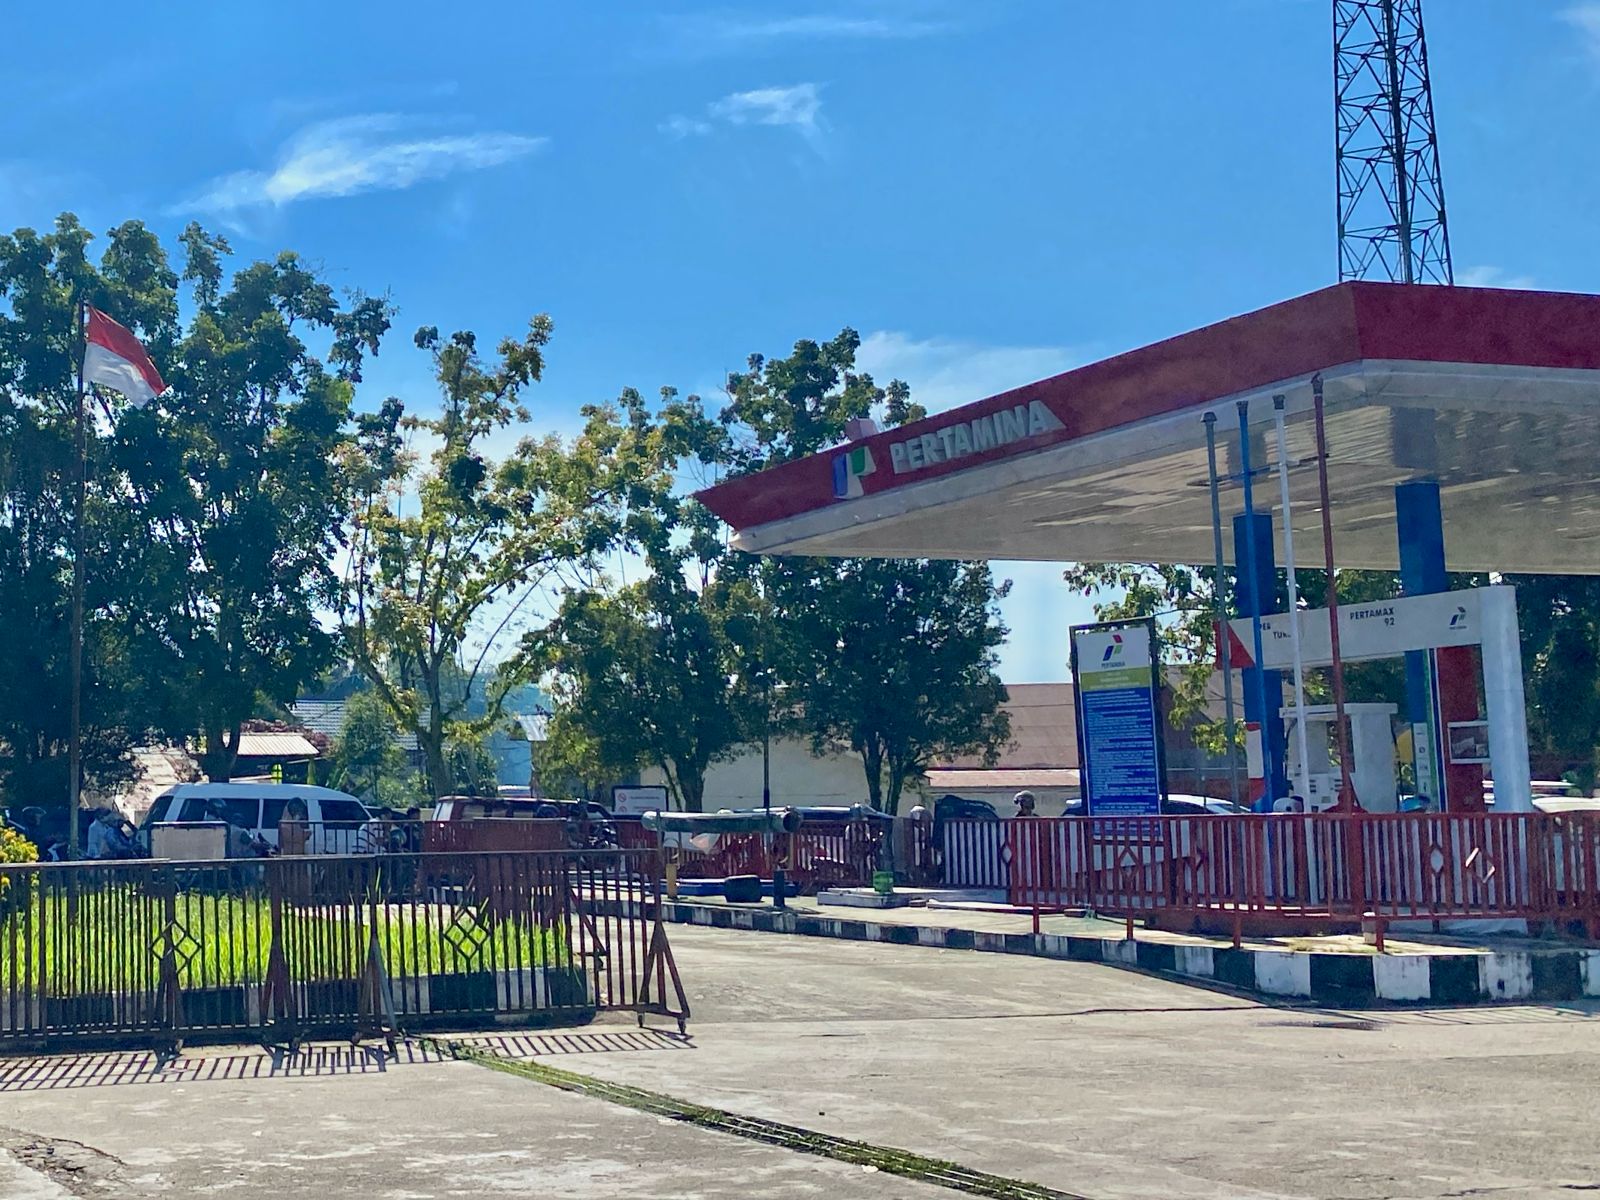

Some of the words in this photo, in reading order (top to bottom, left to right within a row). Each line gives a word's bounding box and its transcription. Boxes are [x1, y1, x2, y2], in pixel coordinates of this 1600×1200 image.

[889, 400, 1067, 474] PERTAMINA
[1350, 607, 1394, 620] PERTAMAX
[1384, 618, 1395, 626] 92
